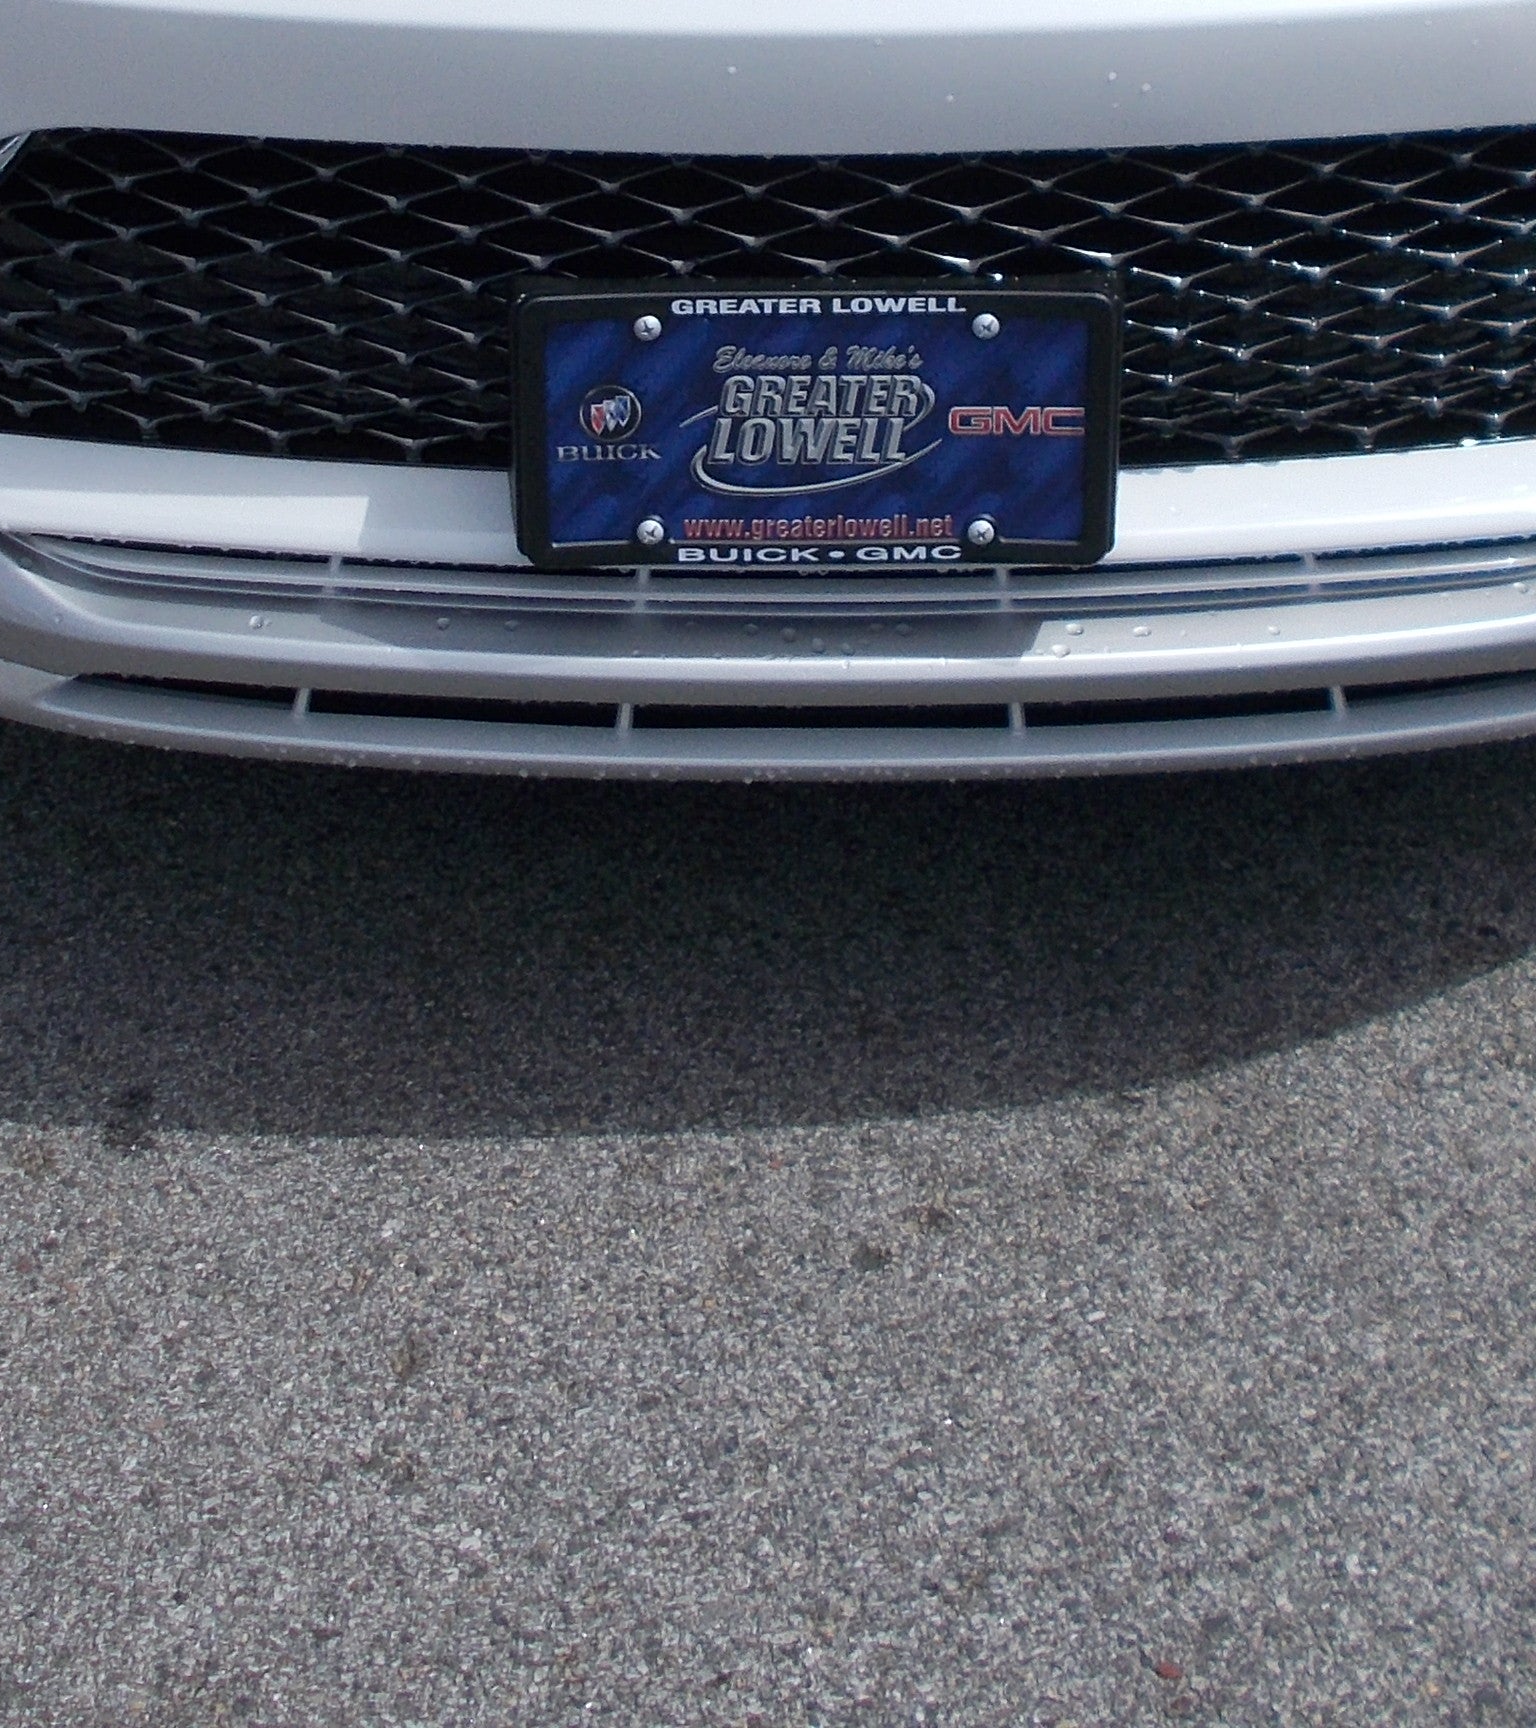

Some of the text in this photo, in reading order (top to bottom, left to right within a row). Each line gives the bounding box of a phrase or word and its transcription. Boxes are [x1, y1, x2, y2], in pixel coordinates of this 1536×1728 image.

[671, 297, 967, 315] GREATER LOWELL
[846, 345, 924, 371] Mike's
[720, 374, 924, 418] GREATER
[948, 406, 1085, 435] GMC
[556, 443, 662, 462] BUICK
[707, 417, 907, 465] LOWELL
[684, 514, 954, 540] www.greaterlowell.net
[678, 545, 962, 562] BUICK GMC
